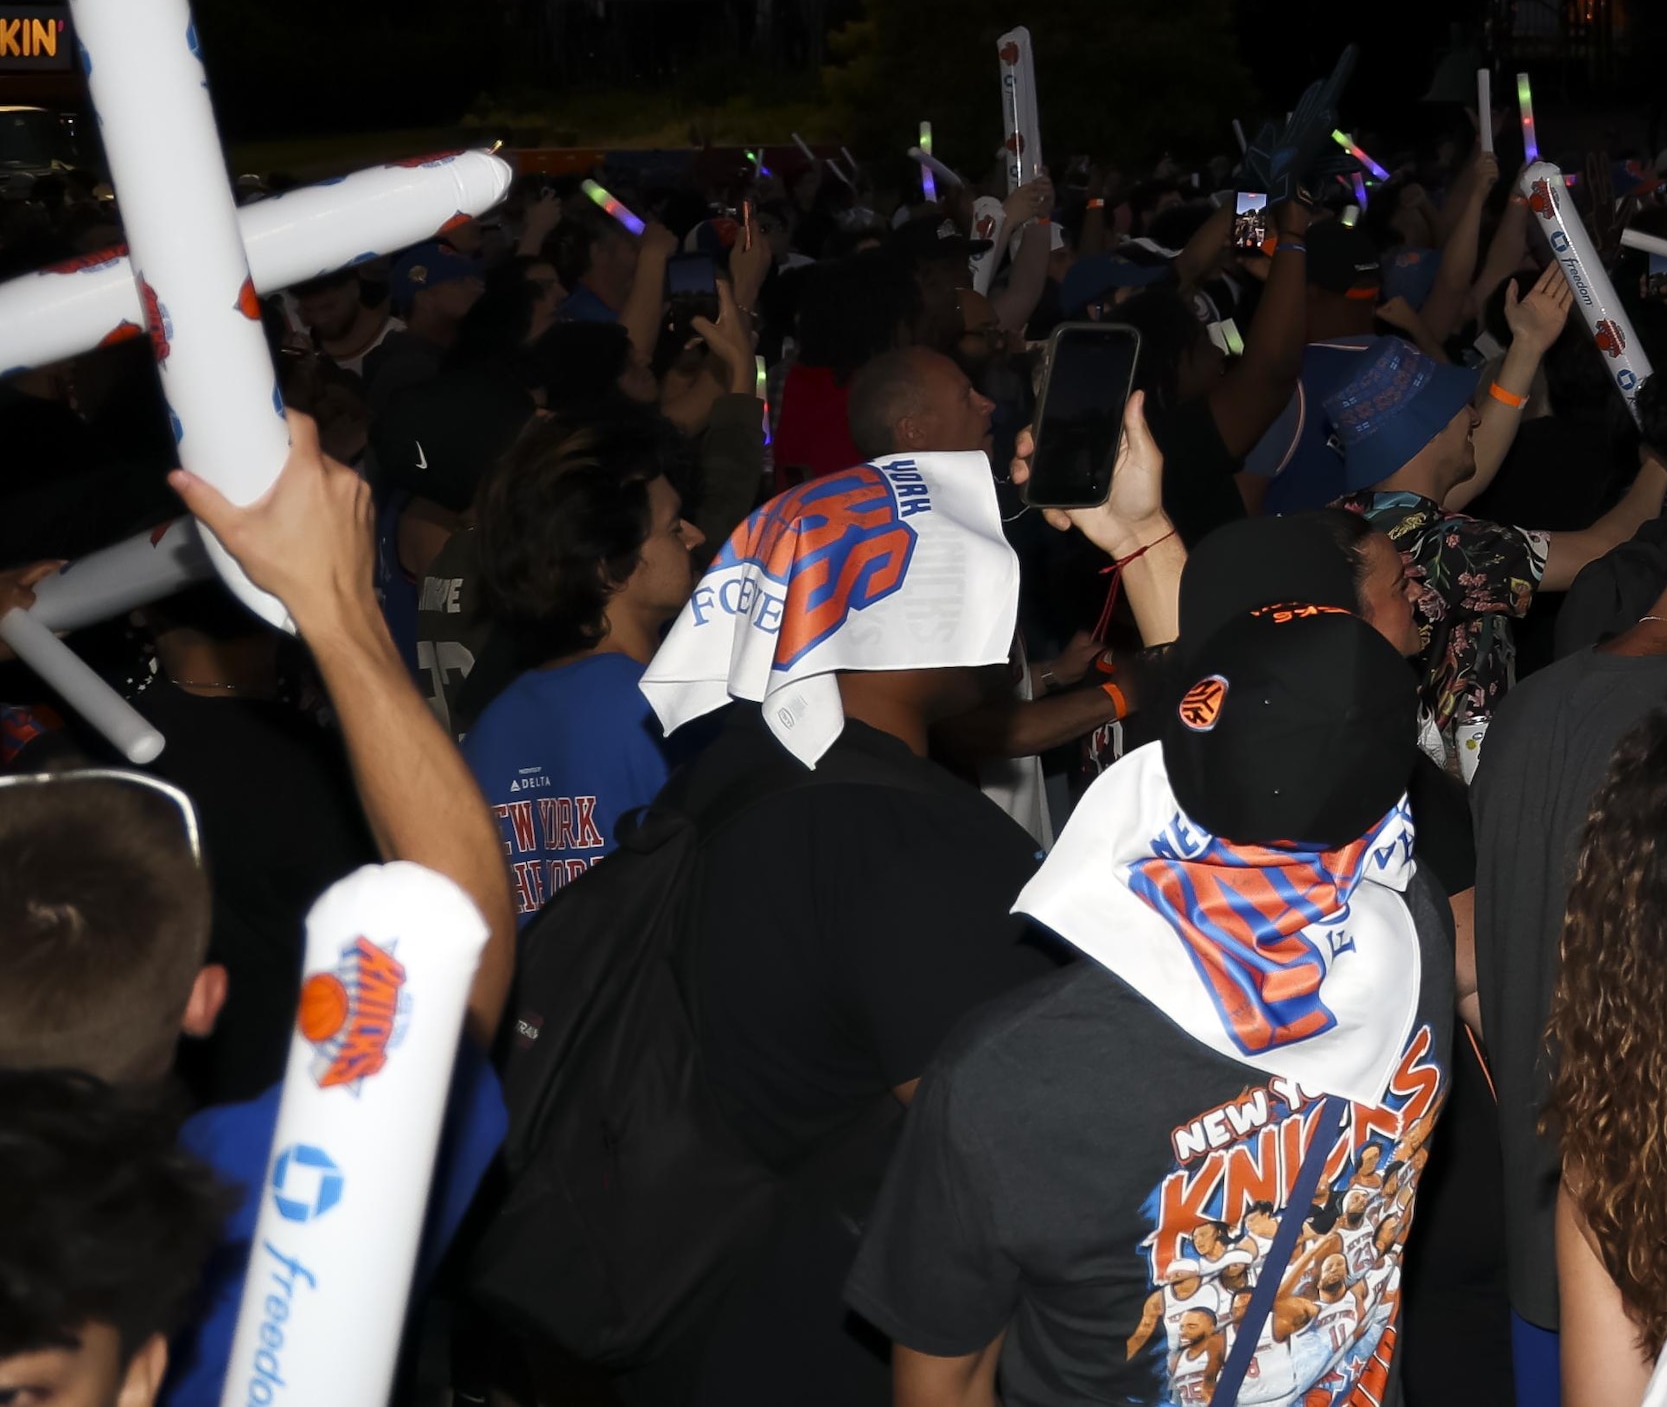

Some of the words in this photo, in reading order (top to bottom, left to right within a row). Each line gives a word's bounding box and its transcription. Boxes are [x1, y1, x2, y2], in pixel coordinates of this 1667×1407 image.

[1561, 256, 1594, 307] freedom
[883, 459, 932, 518] YORK
[521, 776, 551, 791] DELTA
[319, 934, 408, 1090] KNICKS
[1174, 1090, 1269, 1162] NEW
